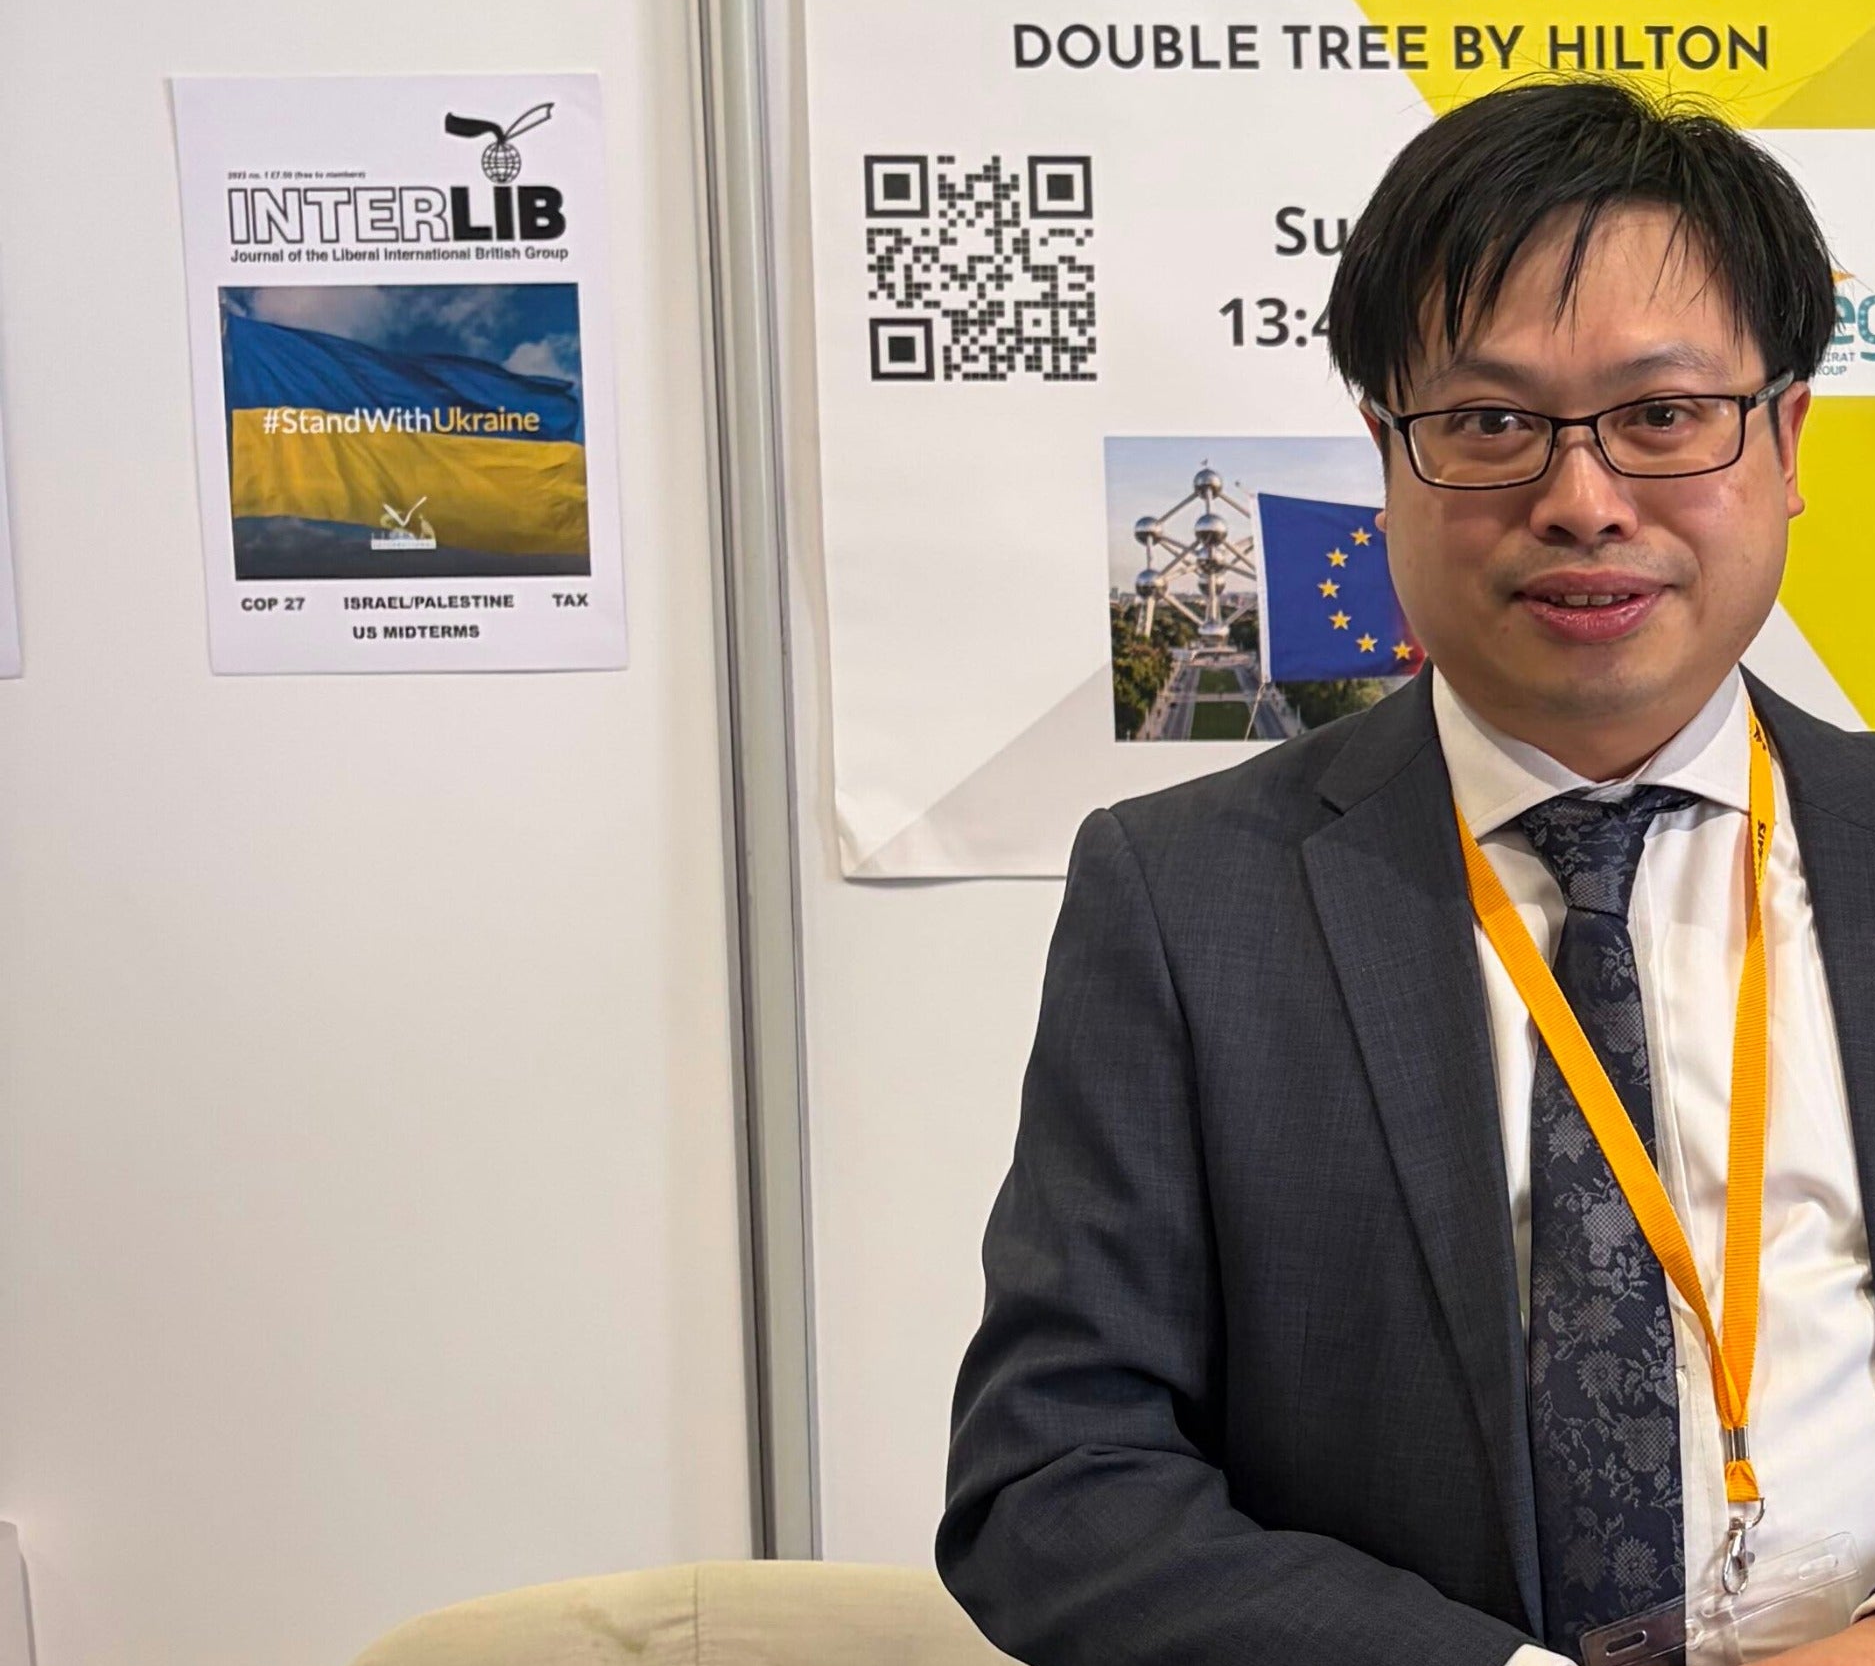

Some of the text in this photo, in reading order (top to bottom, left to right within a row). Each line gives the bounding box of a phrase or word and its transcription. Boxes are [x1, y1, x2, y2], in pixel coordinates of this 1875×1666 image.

[1014, 24, 1768, 71] DOUBLE TREE BY HILTON
[228, 186, 566, 245] INTERLIB
[231, 246, 569, 262] Journal of the Liberal International British Group
[263, 407, 540, 435] #StandWithUkraine
[241, 593, 588, 611] COP 27 ISRAEL/PALESTINE TAX
[353, 625, 479, 639] US MIDTERMS
